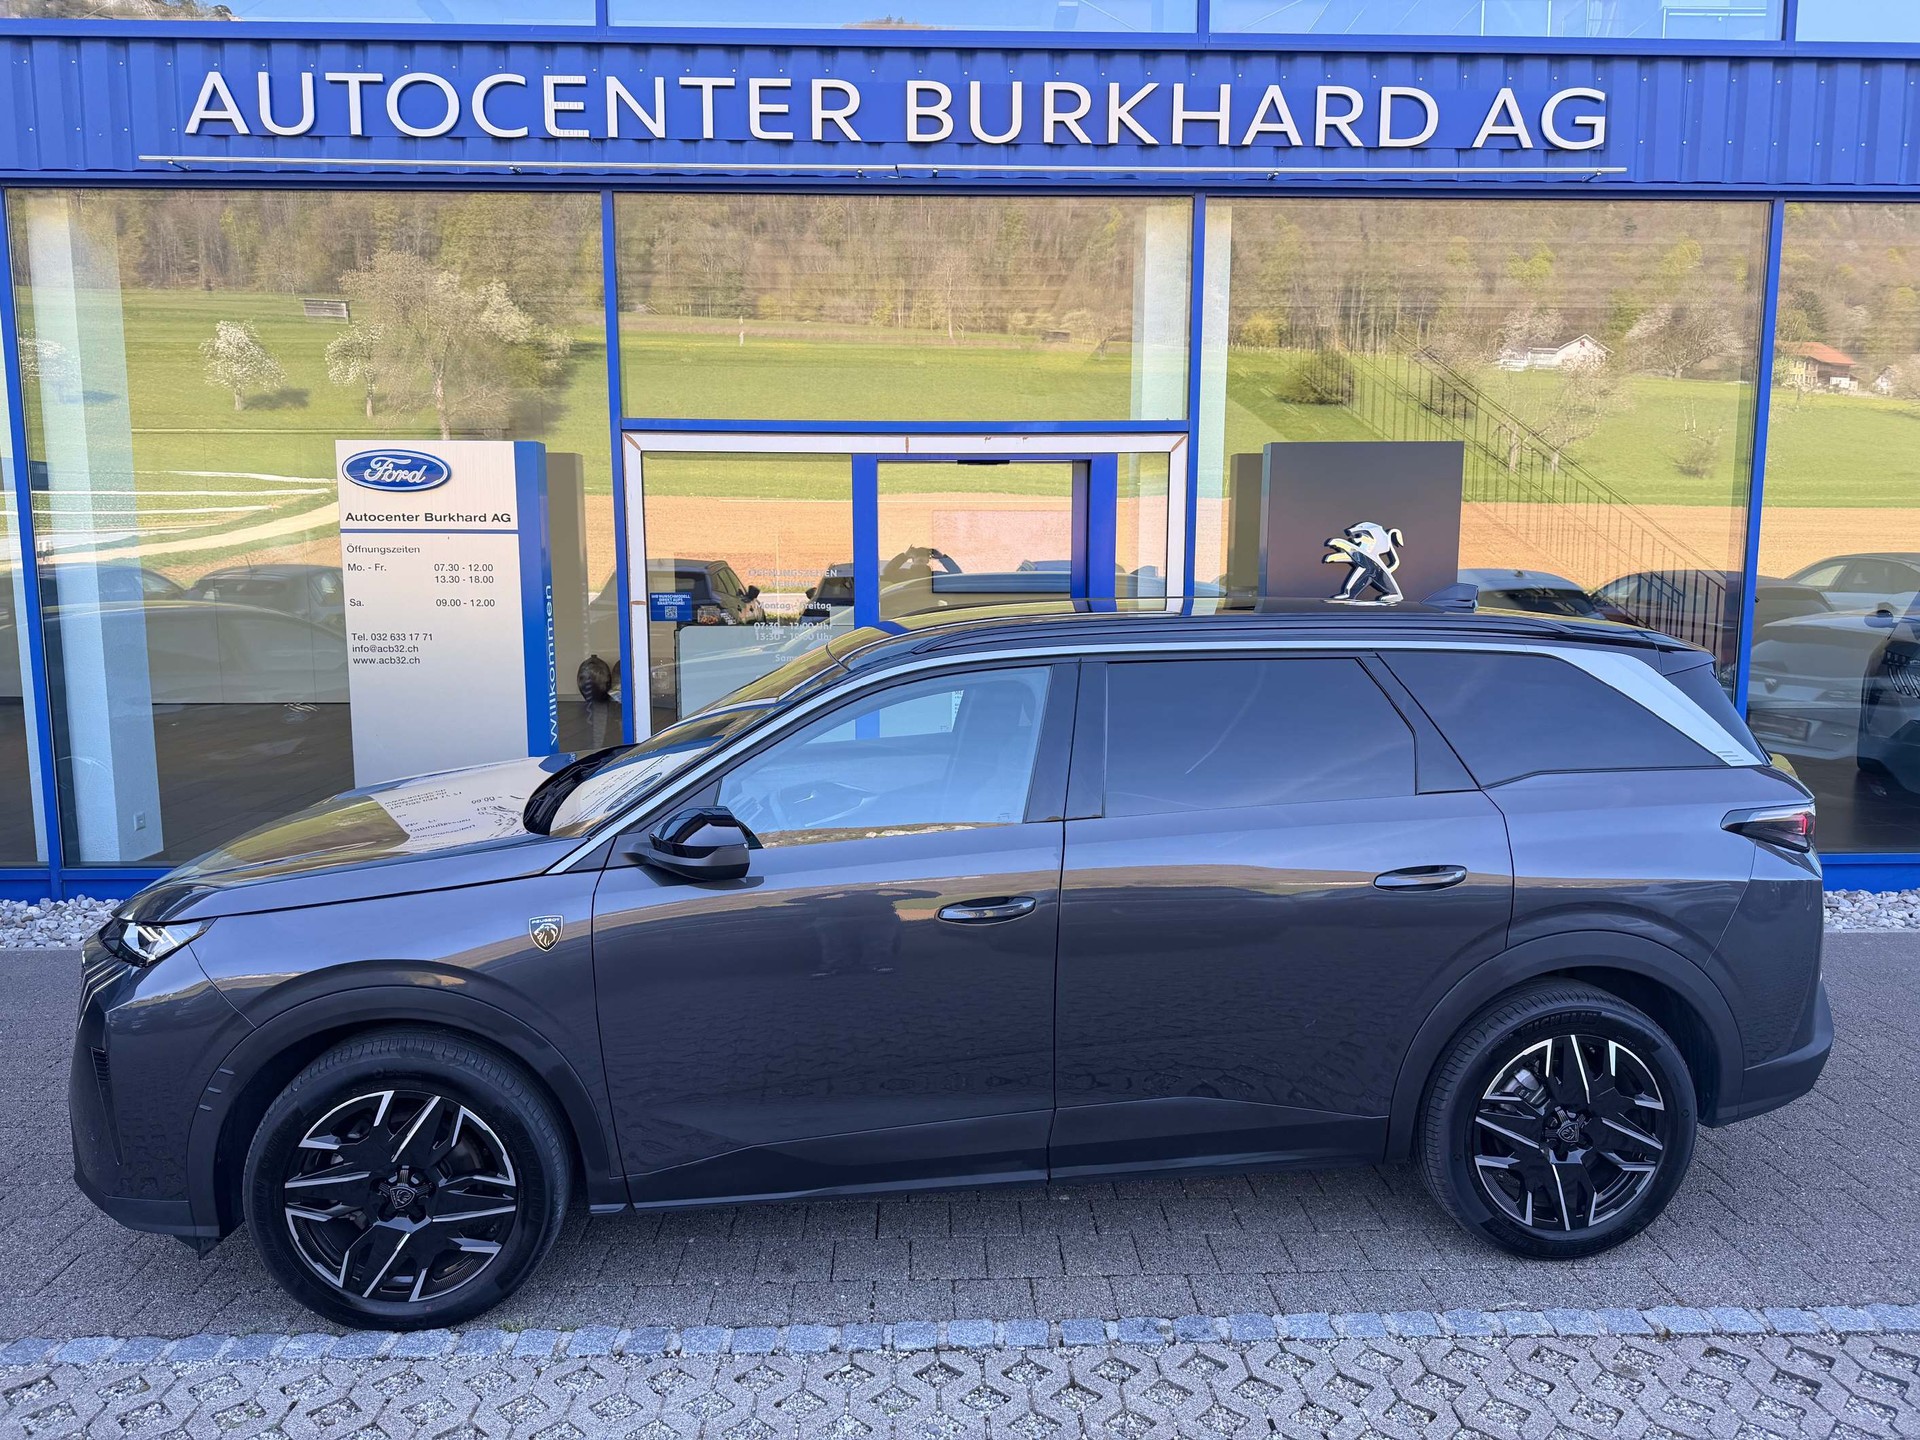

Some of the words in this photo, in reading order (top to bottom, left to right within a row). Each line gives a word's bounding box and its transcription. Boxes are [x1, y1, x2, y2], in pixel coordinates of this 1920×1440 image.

[184, 71, 863, 141] AUTOCENTER
[905, 79, 1441, 149] BURKHARD
[1471, 86, 1607, 151] AG
[363, 456, 428, 484] Ford
[345, 511, 420, 523] Autocenter
[424, 511, 487, 523] Burkhard
[491, 512, 511, 523] AG
[346, 543, 421, 556] Öffnungszeiten
[347, 563, 366, 572] Mo.
[374, 563, 387, 572] Fr.
[433, 563, 460, 572] 07.30
[468, 563, 494, 572] 12.00
[435, 575, 460, 584] 13.30
[469, 575, 494, 584] 18.00
[349, 598, 365, 607] Sa.
[435, 598, 462, 607] 09.00
[470, 598, 496, 607] 12.00
[756, 602, 792, 612] Montag
[753, 622, 780, 630] 07:30
[351, 632, 369, 641] Tel.
[370, 632, 388, 641] 032
[390, 632, 407, 641] 633
[409, 632, 420, 641] 17
[422, 632, 433, 641] 71
[352, 644, 419, 653] info@acb32.ch
[352, 656, 421, 665] www.acb32.ch
[545, 585, 558, 746] Willkommen
